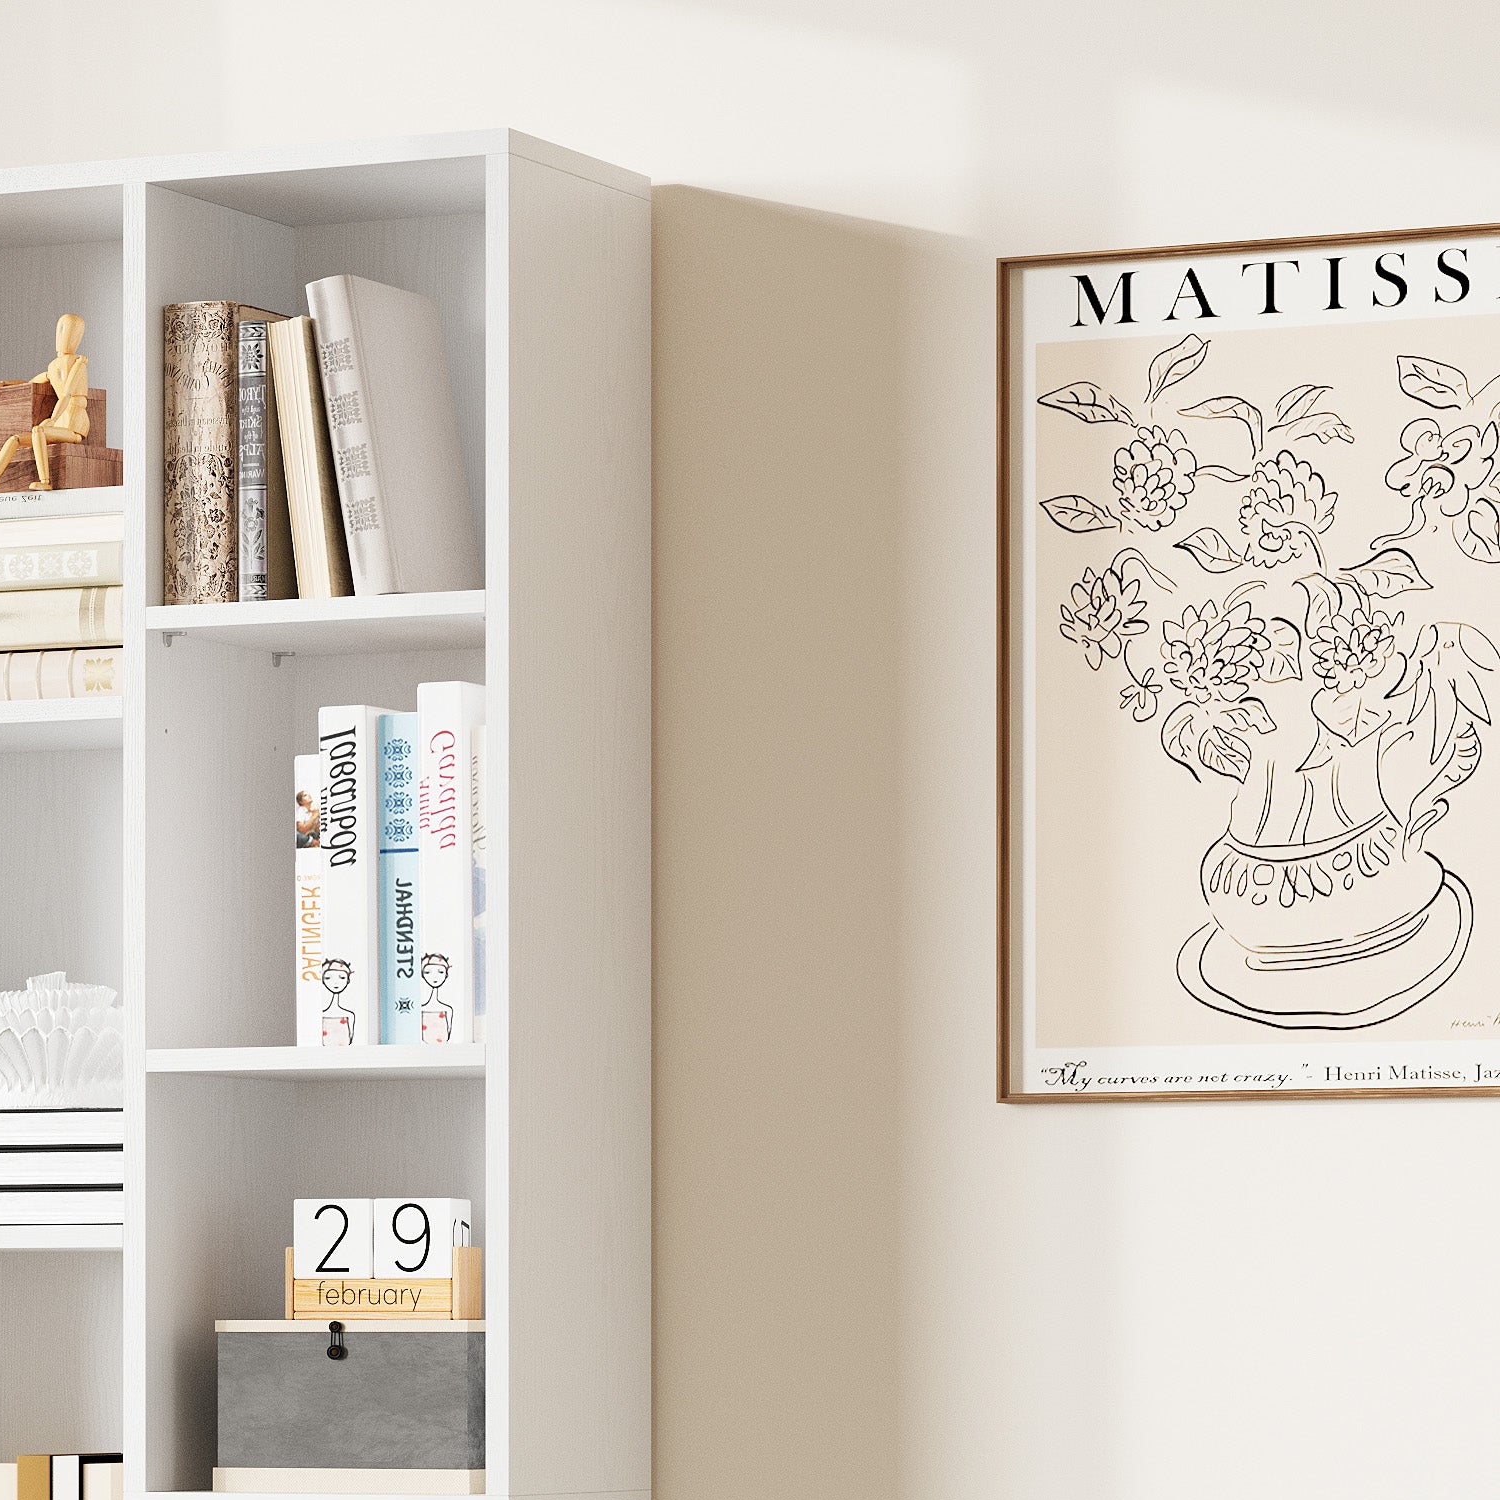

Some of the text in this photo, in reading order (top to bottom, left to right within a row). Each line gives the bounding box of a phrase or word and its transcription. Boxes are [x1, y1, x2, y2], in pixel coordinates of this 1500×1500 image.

[1069, 246, 1500, 328] MATISS
[1097, 1074, 1160, 1086] curves
[1163, 1074, 1194, 1085] are
[1197, 1071, 1229, 1083] not
[1324, 1066, 1382, 1082] Henri
[1387, 1065, 1468, 1082] Matisse,
[316, 1280, 422, 1312] february
